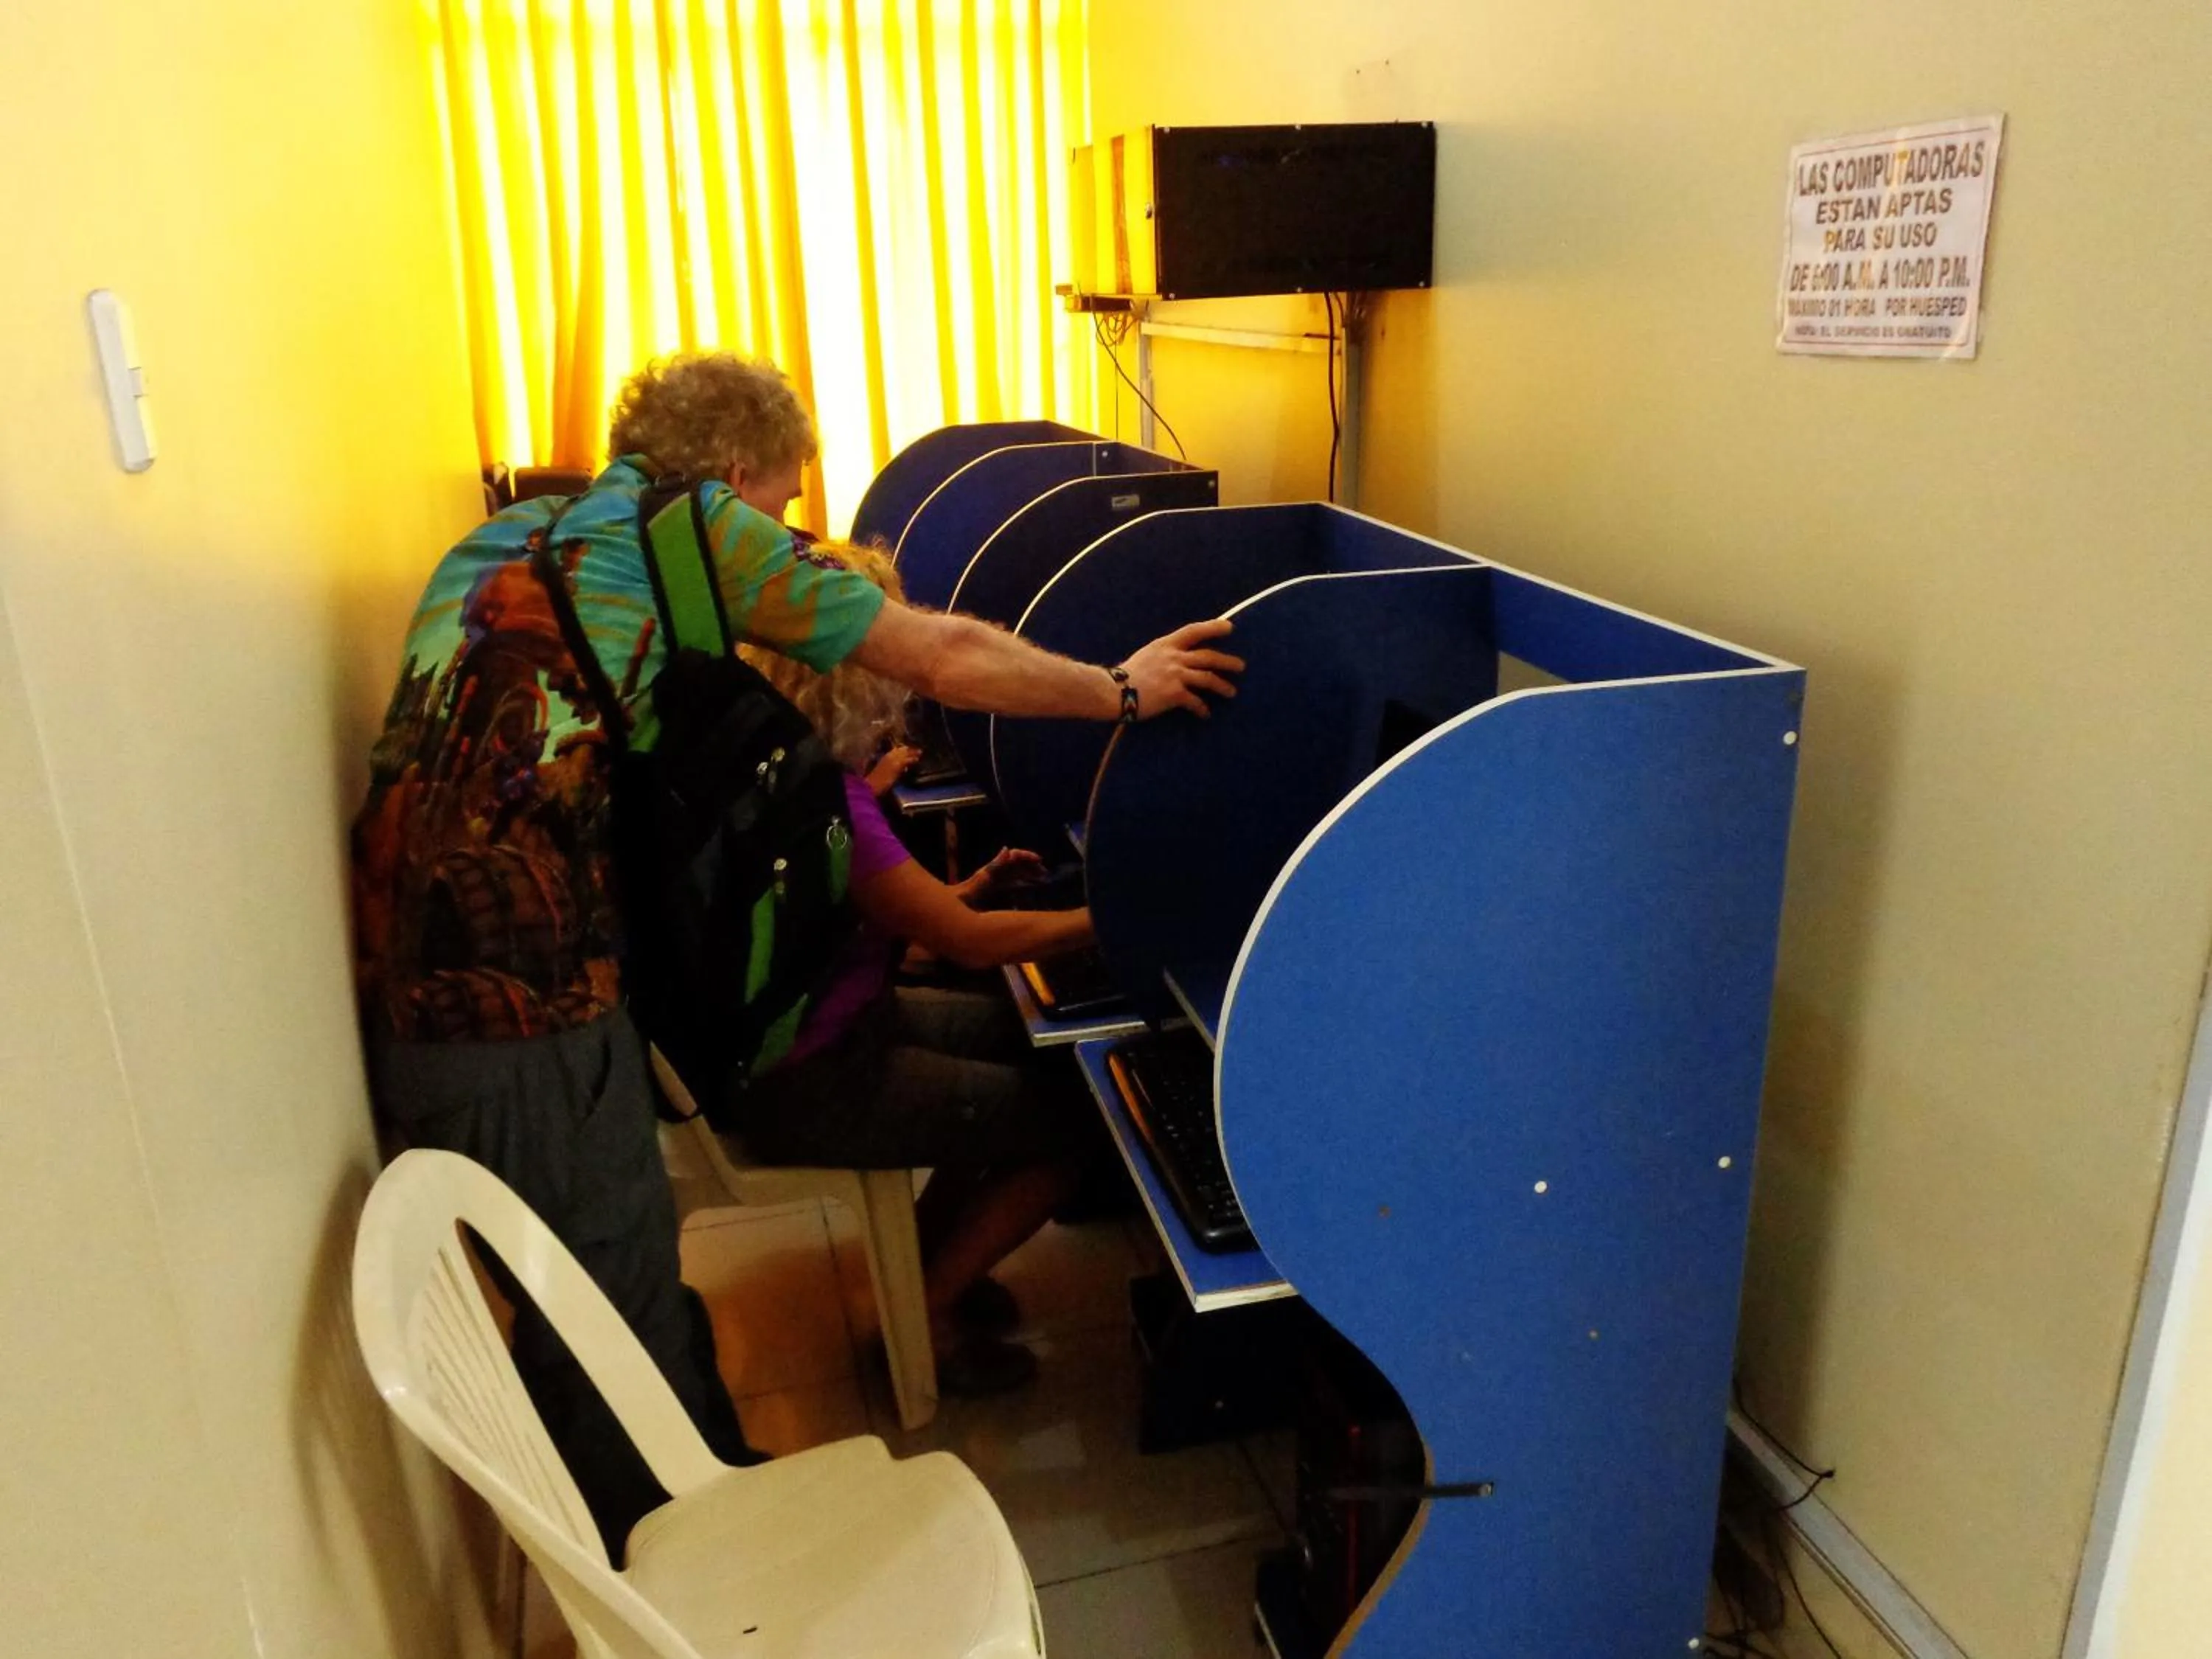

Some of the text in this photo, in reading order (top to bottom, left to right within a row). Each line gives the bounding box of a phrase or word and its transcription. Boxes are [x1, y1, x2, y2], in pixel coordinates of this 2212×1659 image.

[1799, 140, 1986, 196] LAS COMPUTADORAS
[1816, 187, 1953, 224] ESTAN APTAS
[1823, 221, 1938, 253] PARA SU USO
[1790, 263, 1810, 291] DE
[1878, 260, 1888, 289] A
[1893, 257, 1934, 288] 10:00
[1937, 257, 1971, 287] P.M.
[1844, 298, 1876, 317] HORA
[1885, 296, 1906, 317] POR
[1910, 296, 1966, 317] HUESPED
